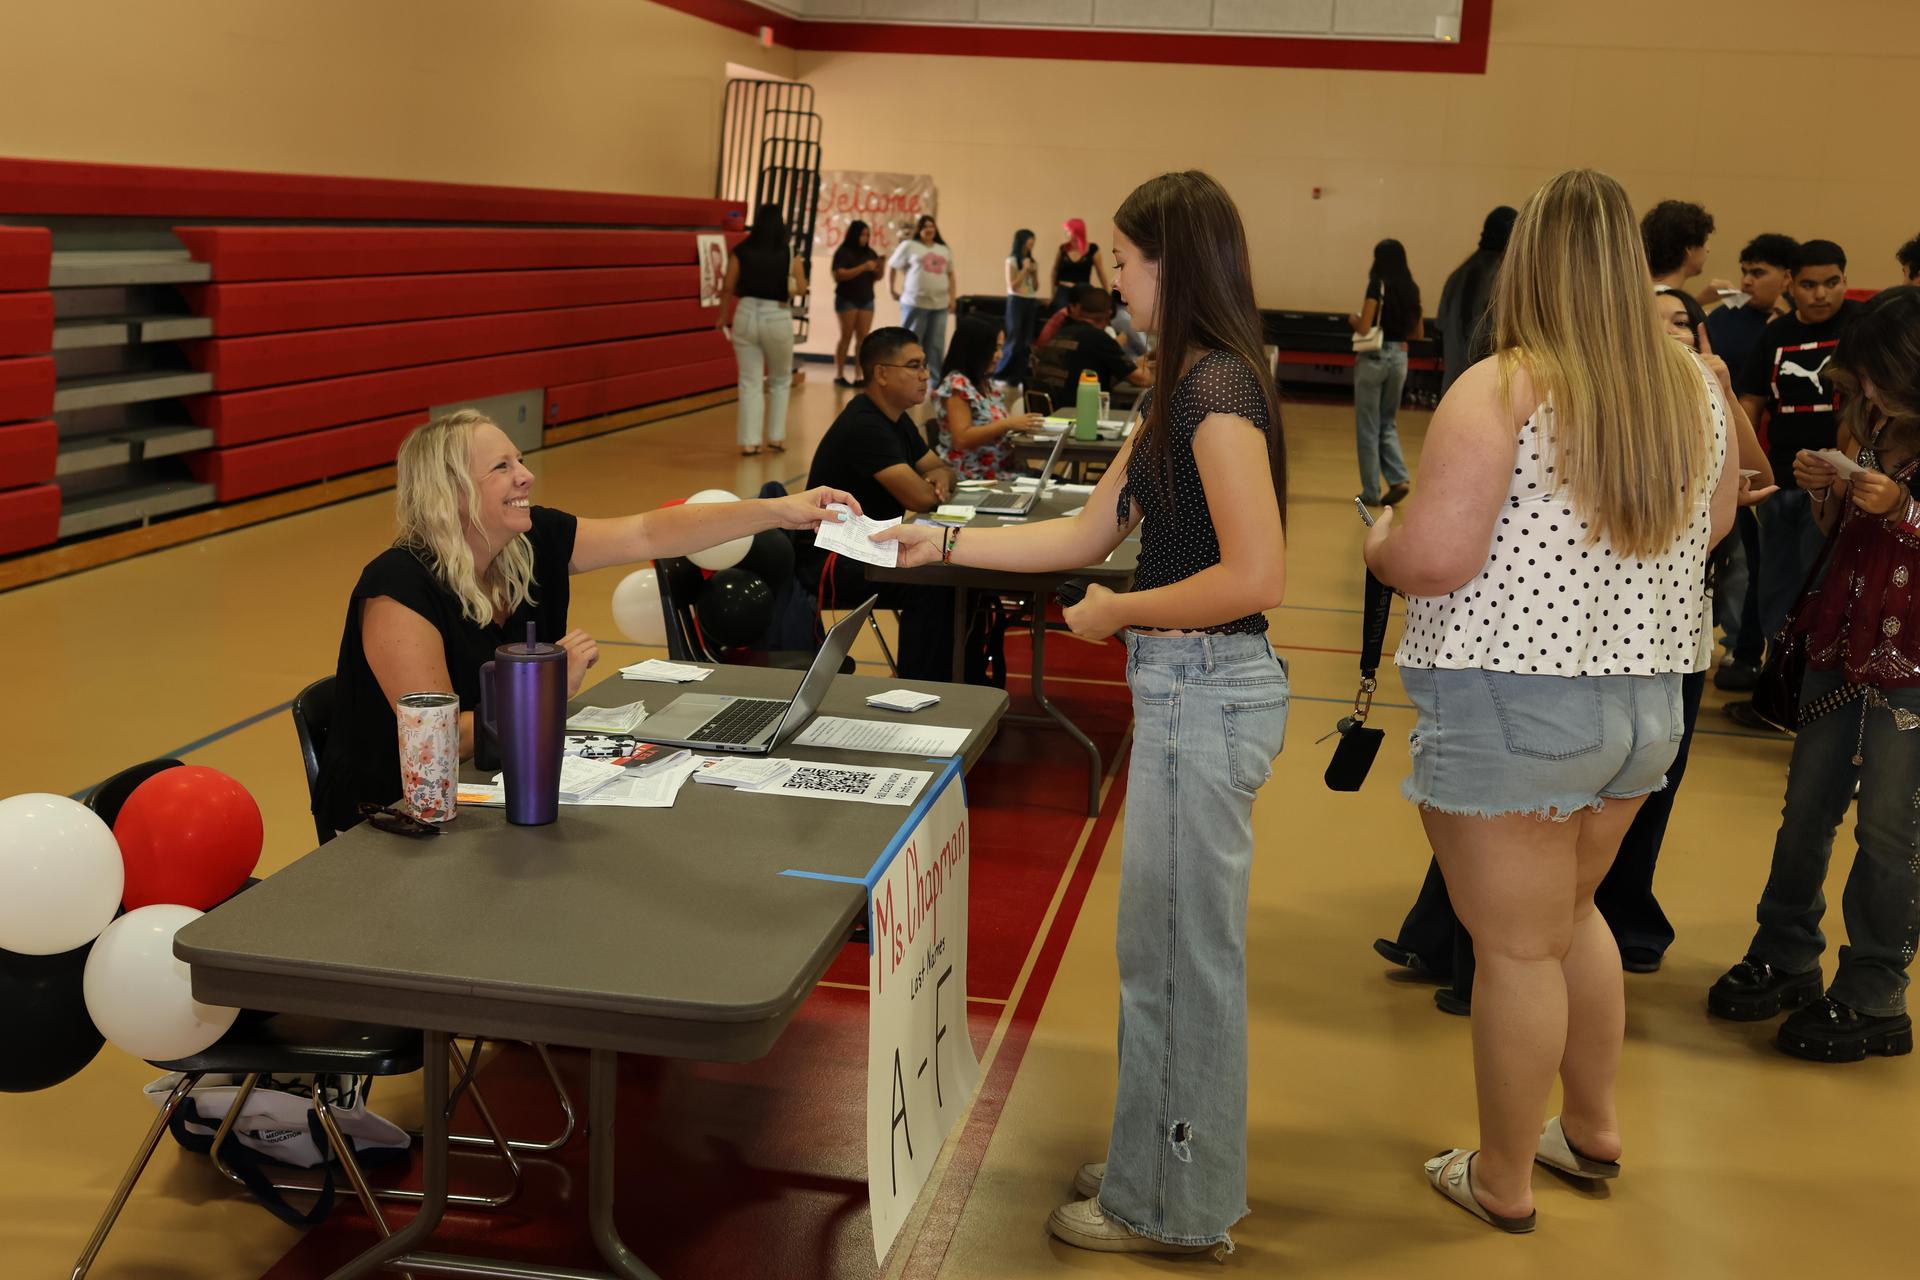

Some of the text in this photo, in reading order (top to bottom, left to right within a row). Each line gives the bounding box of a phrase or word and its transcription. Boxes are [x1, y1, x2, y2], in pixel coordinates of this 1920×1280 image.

[822, 217, 890, 248] bk
[905, 820, 965, 945] Chapman
[910, 936, 945, 1000] Last Names
[891, 1047, 913, 1197] A
[936, 964, 952, 1108] F
